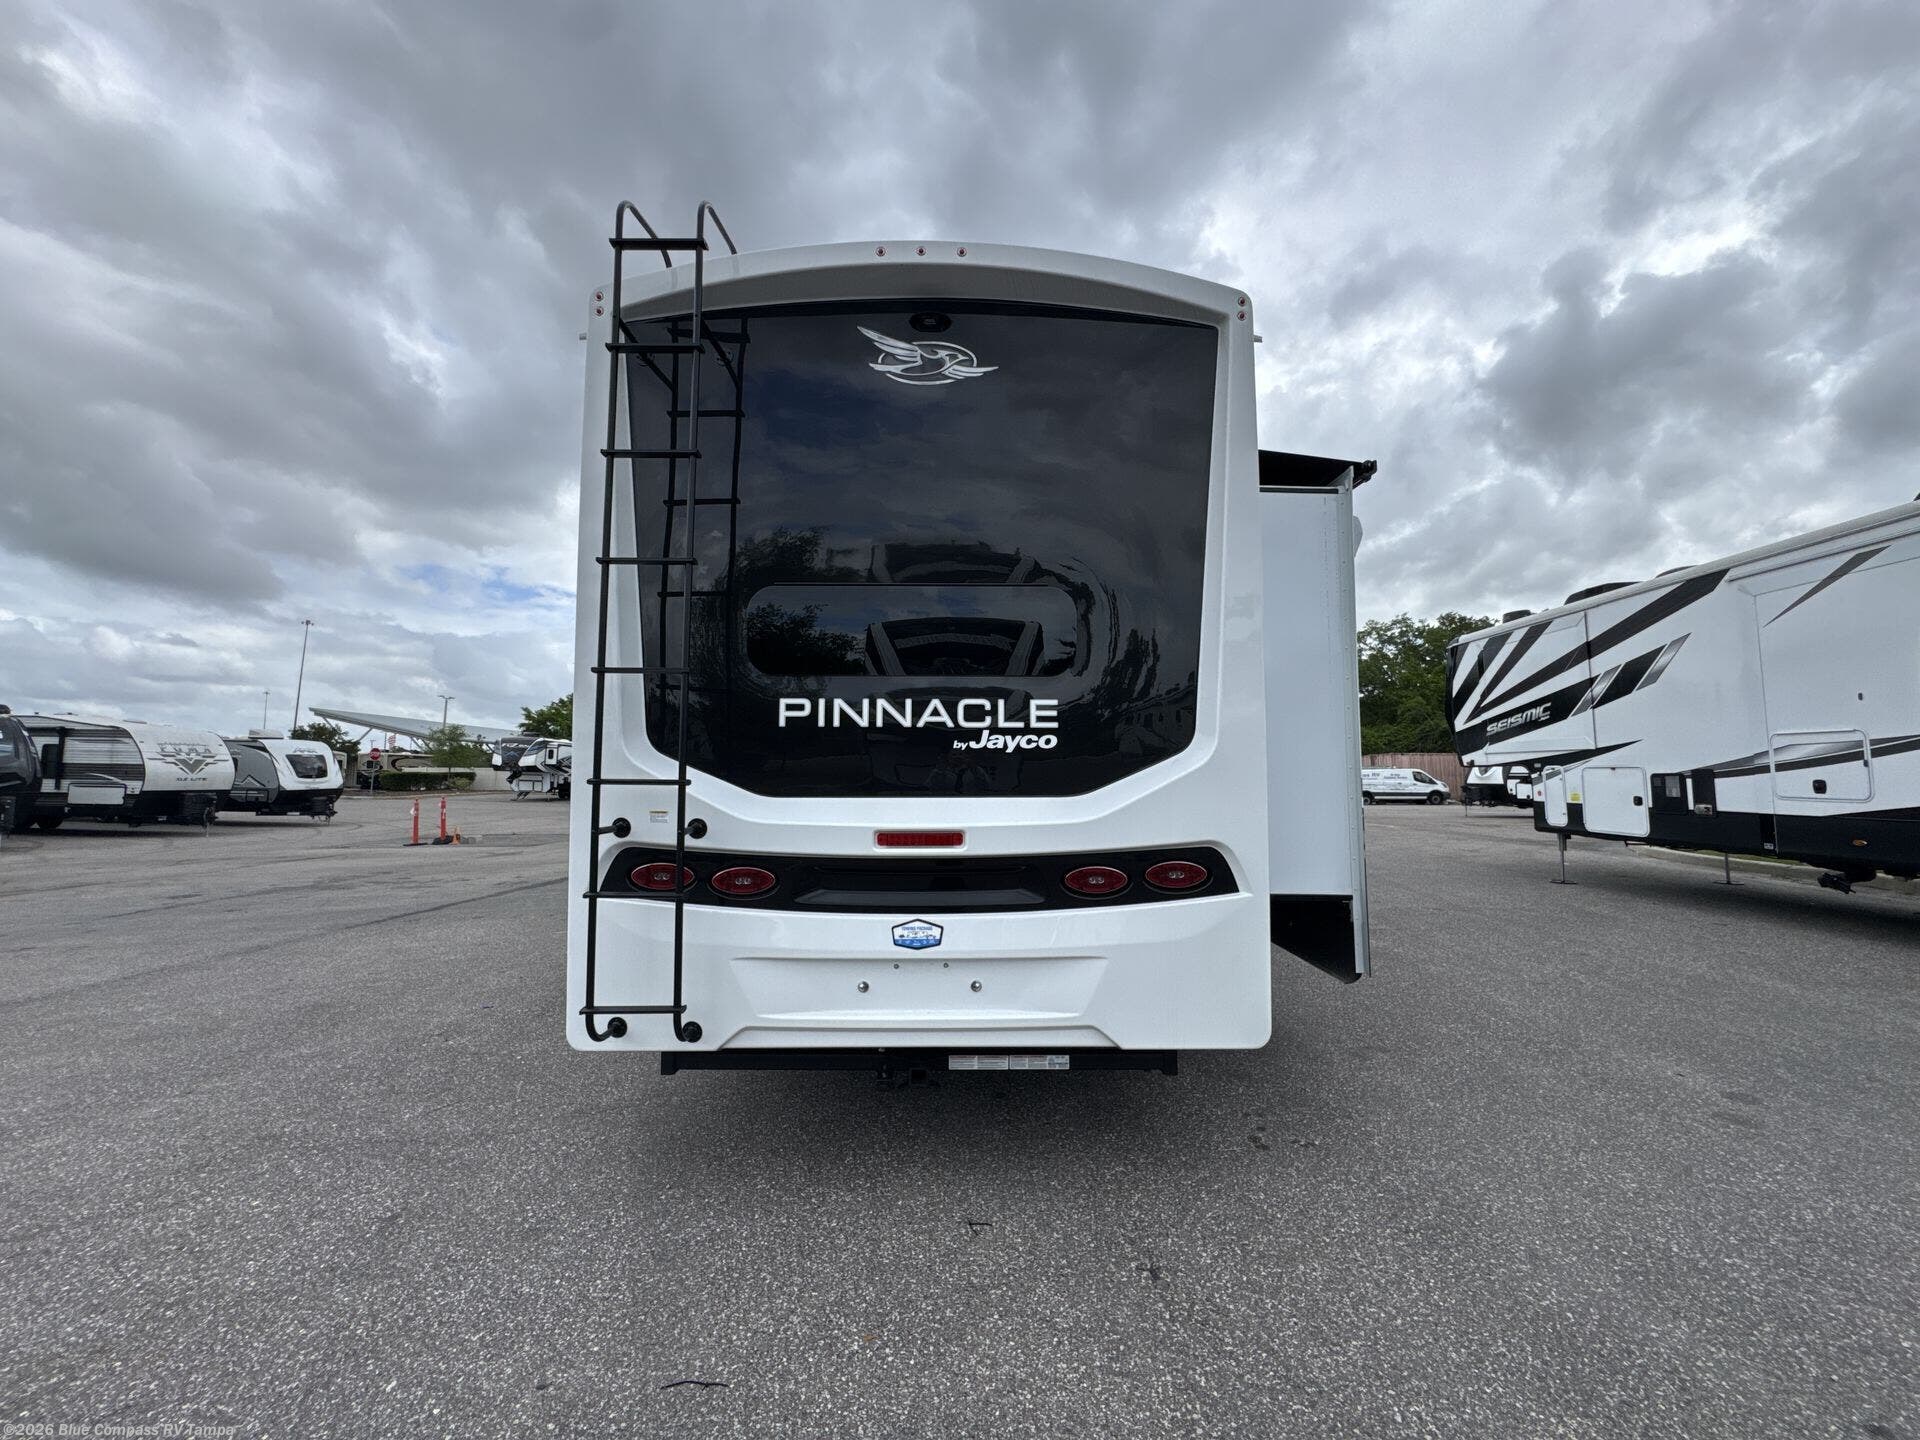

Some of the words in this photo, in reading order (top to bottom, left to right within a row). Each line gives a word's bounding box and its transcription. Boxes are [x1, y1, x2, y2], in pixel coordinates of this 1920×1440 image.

[778, 697, 1059, 729] PINNACLE
[1486, 702, 1552, 736] SEISMIC
[953, 739, 968, 751] by
[969, 730, 1058, 753] Jayco
